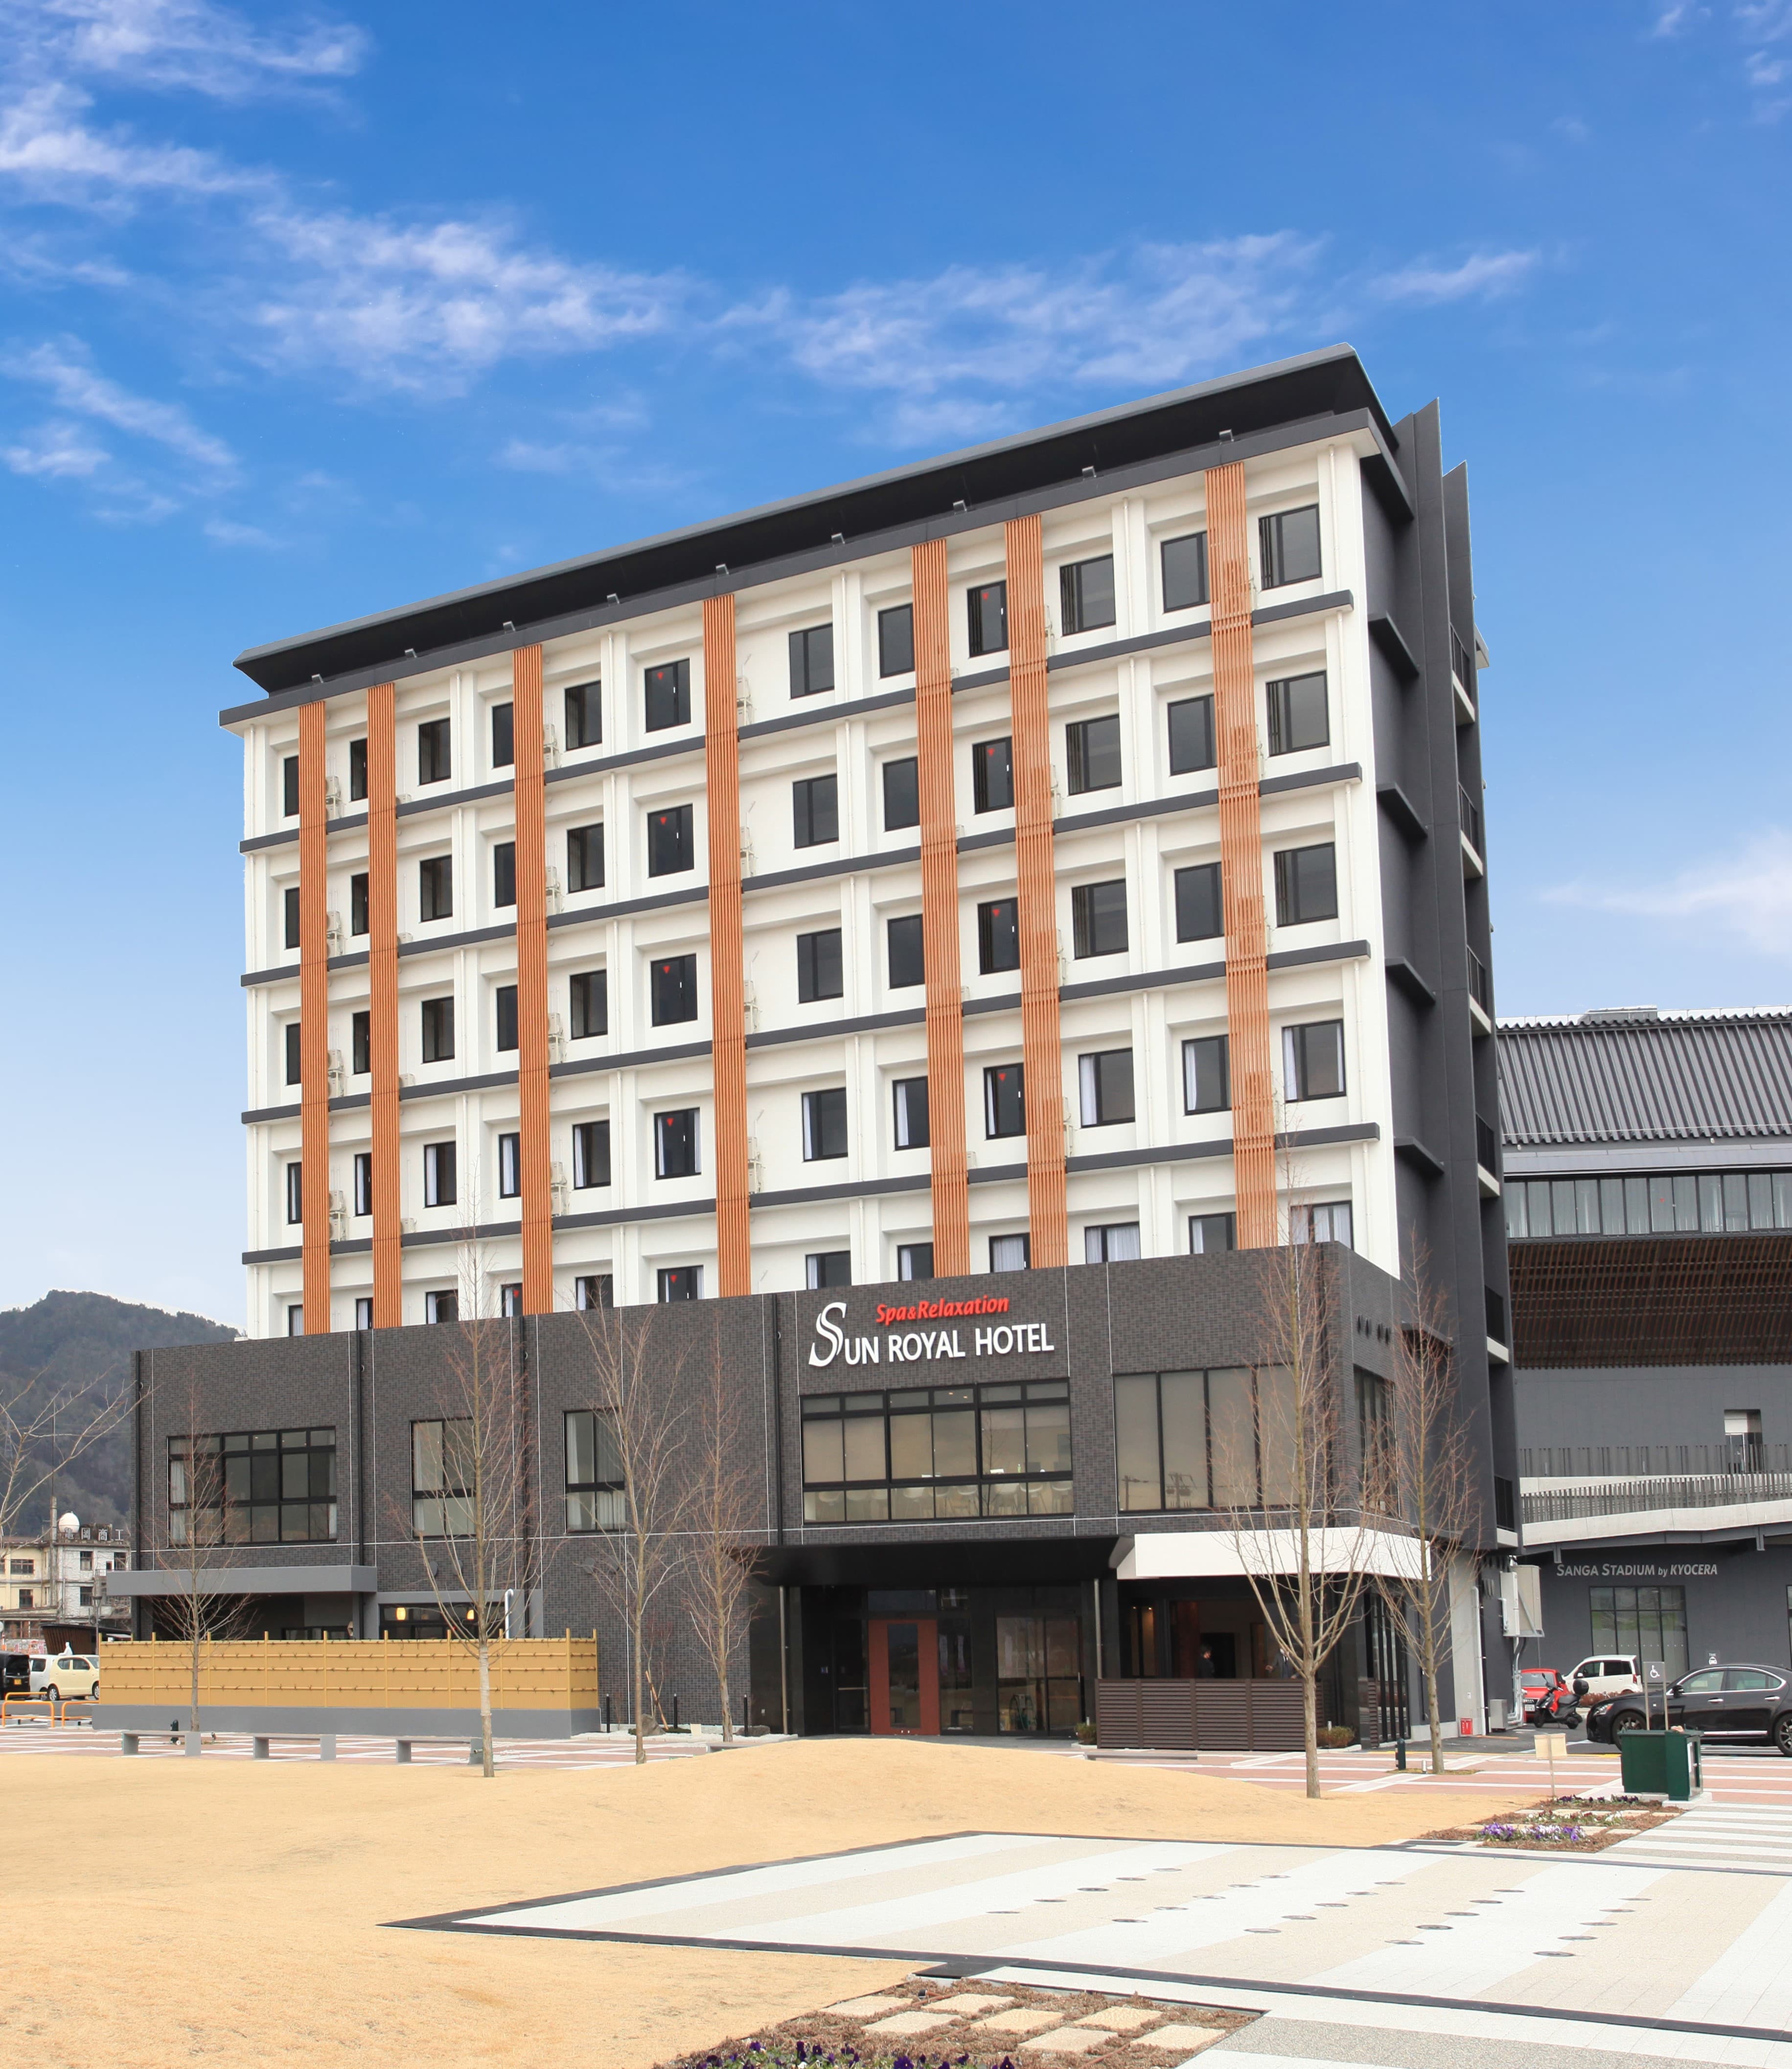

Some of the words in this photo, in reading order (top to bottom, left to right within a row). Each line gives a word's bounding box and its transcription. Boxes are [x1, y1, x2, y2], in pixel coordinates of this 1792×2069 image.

[875, 1295, 1009, 1325] Spa&Relaxation
[808, 1302, 879, 1367] SUN
[889, 1330, 965, 1362] ROYAL
[975, 1323, 1055, 1356] HOTEL
[1557, 1564, 1599, 1576] SANGA
[1602, 1564, 1655, 1576] STADIUM
[1658, 1567, 1668, 1577] by
[1670, 1564, 1718, 1575] KYOCERA
